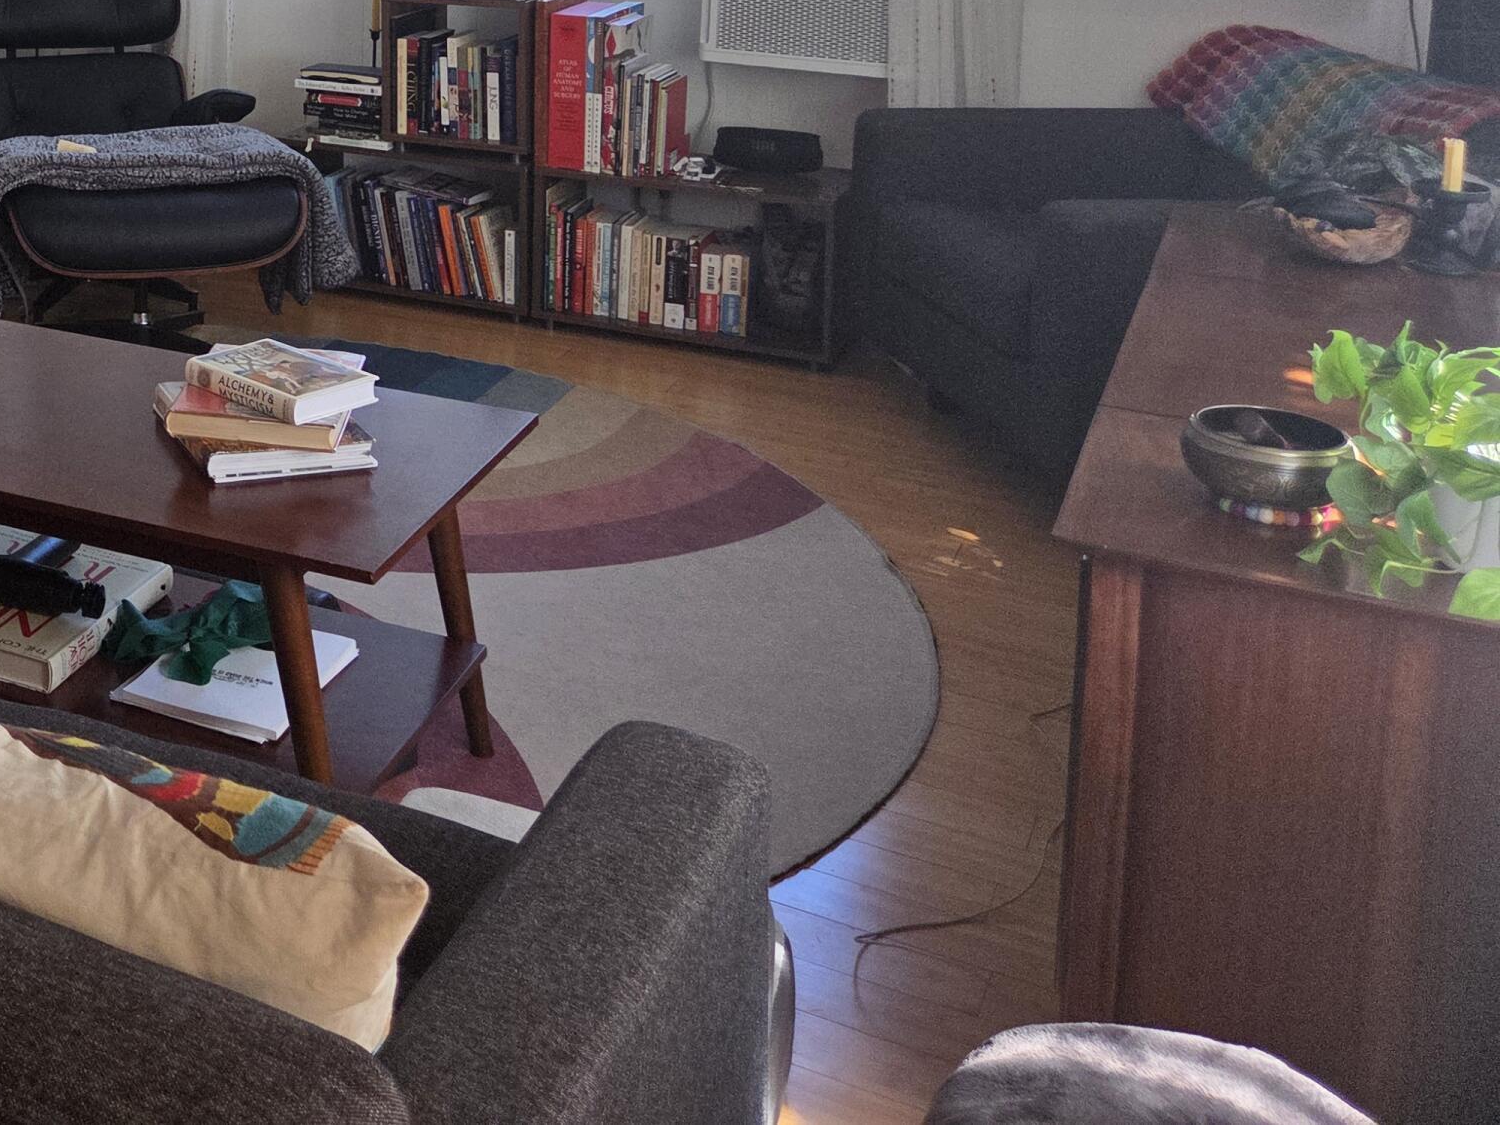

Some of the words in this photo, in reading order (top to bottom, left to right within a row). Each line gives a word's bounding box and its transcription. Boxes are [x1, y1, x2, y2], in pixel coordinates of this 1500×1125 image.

[407, 70, 418, 112] CHING
[487, 86, 498, 111] JUNG
[371, 214, 383, 251] DIGNITY
[219, 387, 275, 414] MYSTICISM
[26, 643, 47, 655] THE
